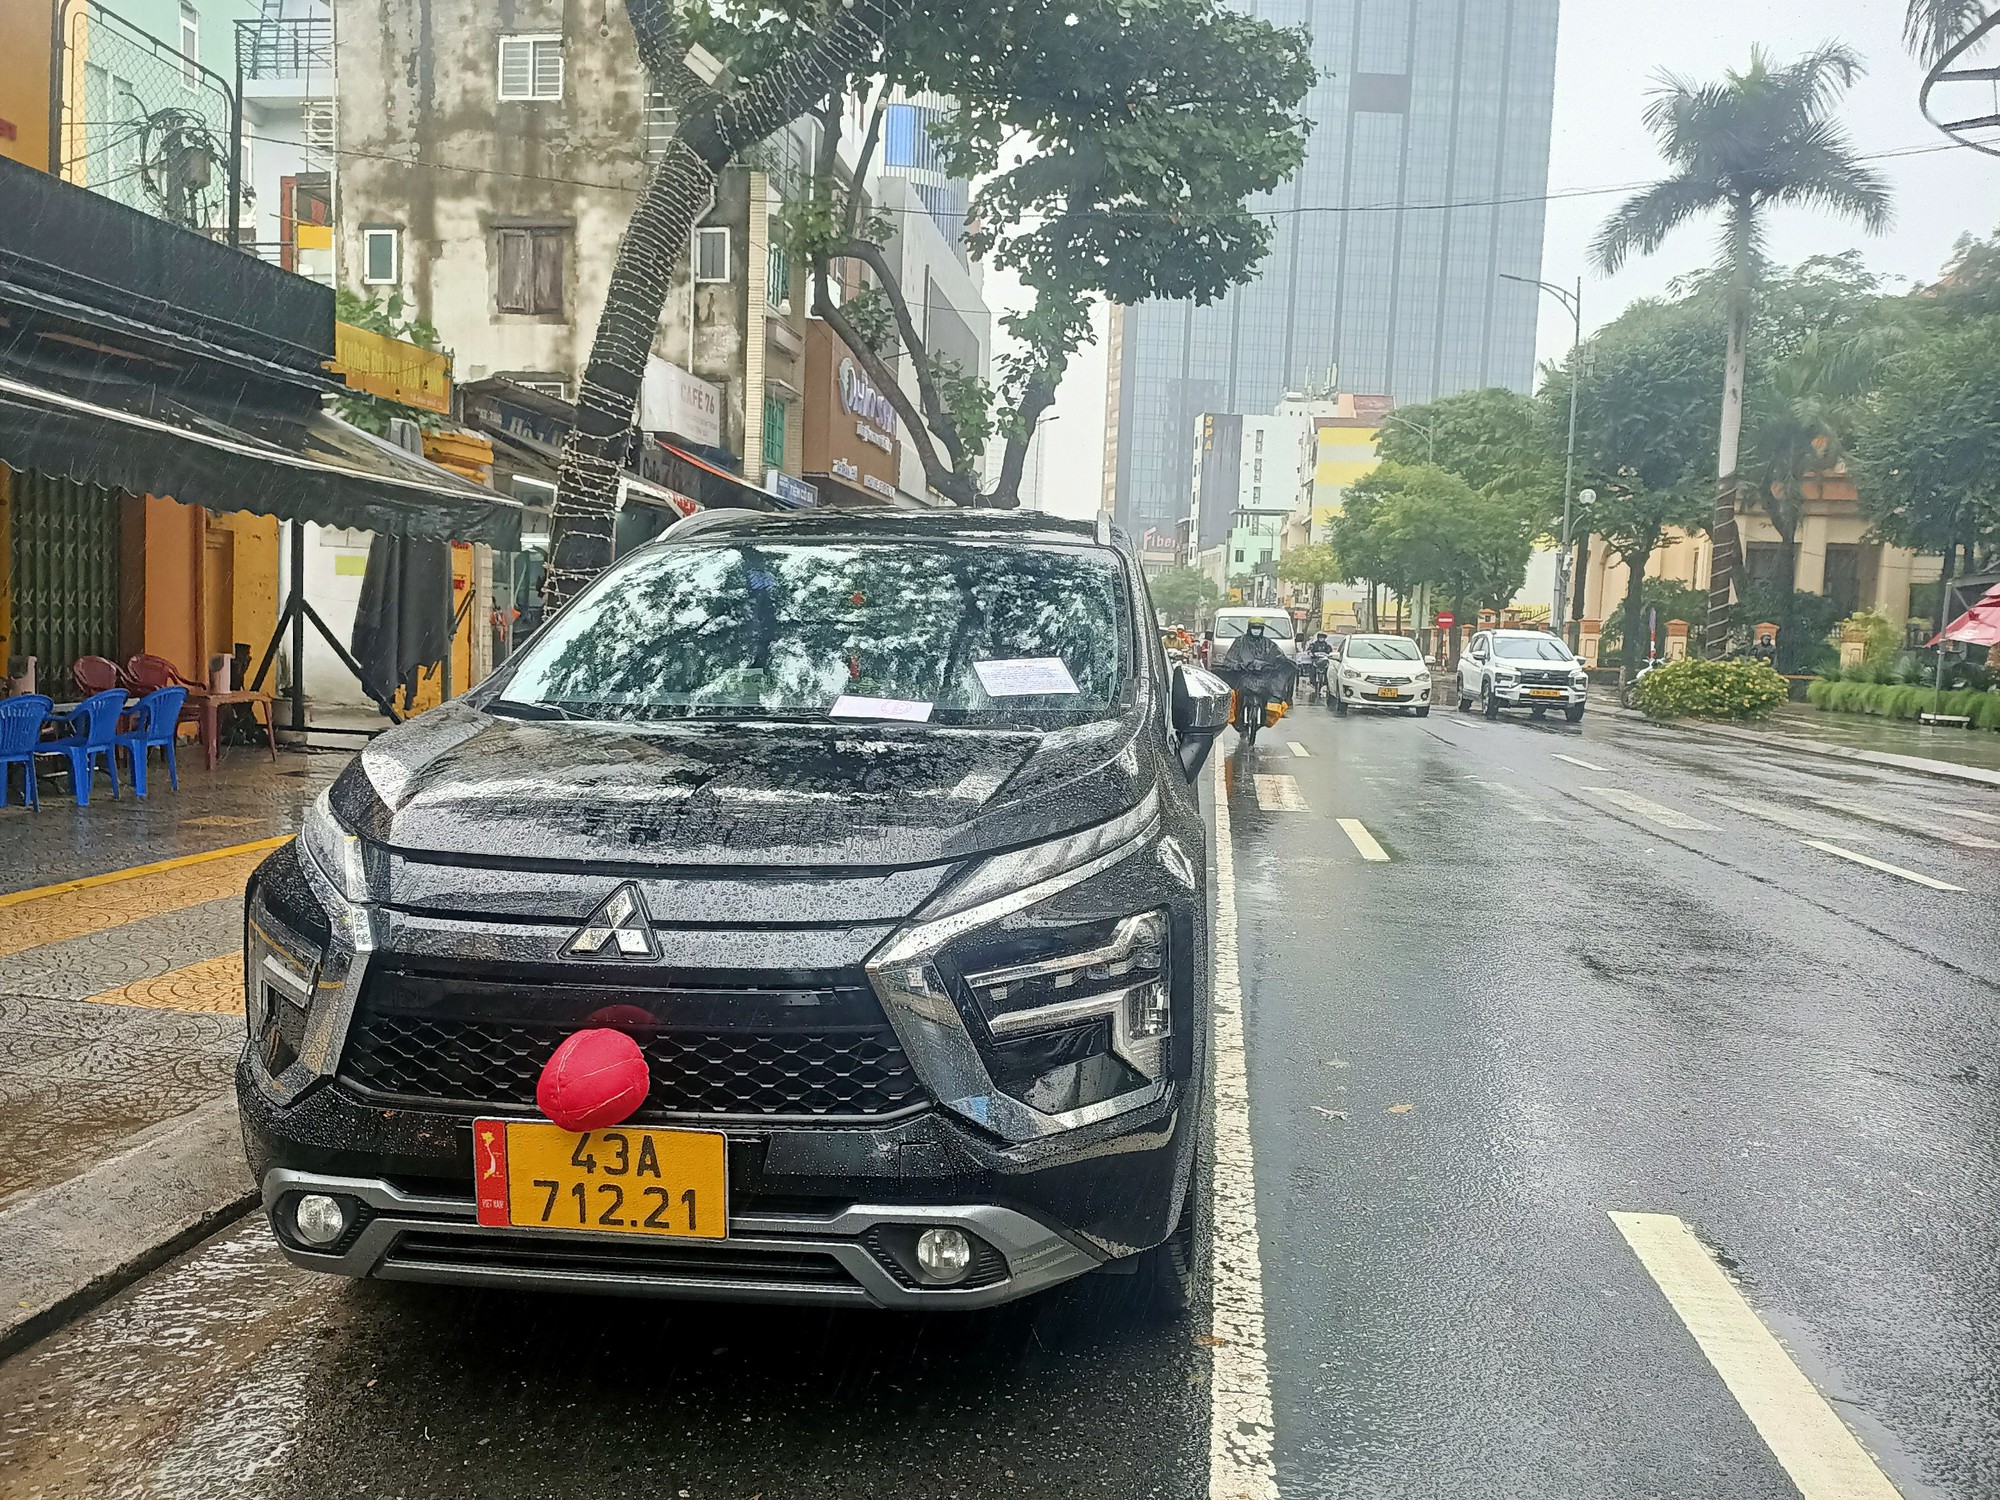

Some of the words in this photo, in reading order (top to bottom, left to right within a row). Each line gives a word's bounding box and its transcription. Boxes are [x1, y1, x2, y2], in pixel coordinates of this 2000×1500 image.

[680, 383, 704, 411] CAFÉ
[1204, 416, 1214, 450] SPA
[571, 1132, 662, 1178] 43A
[533, 1179, 697, 1230] 712.21
